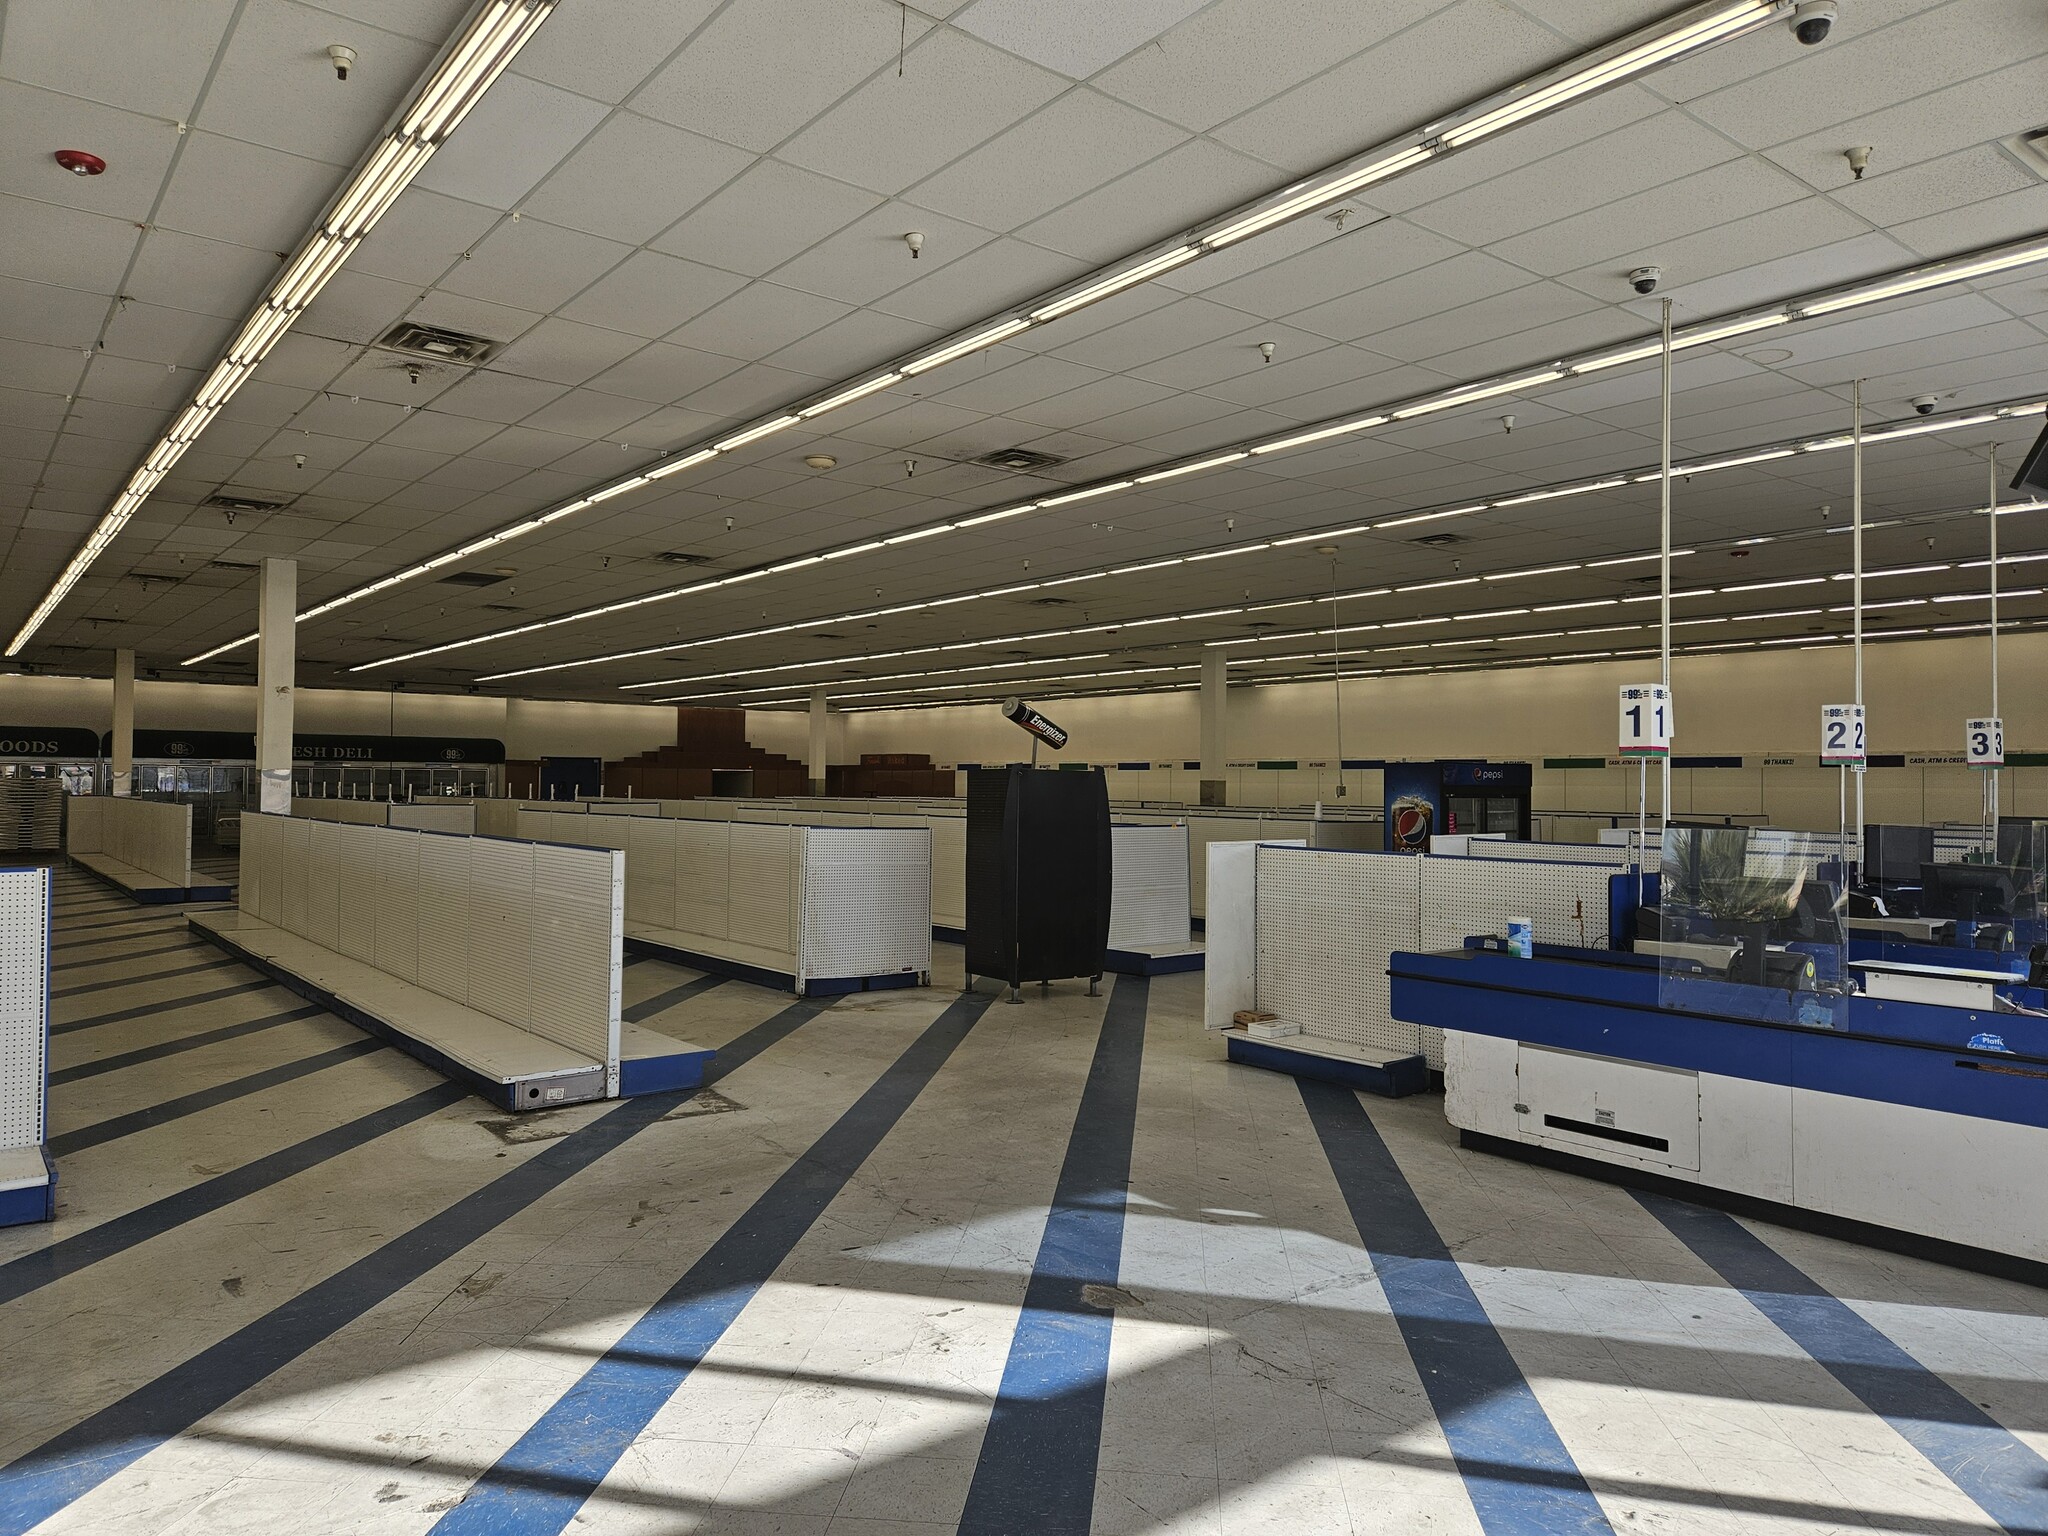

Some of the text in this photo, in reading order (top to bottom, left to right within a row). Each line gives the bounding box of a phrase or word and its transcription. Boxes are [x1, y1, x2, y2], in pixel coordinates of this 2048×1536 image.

[1030, 714, 1066, 742] Energizer
[1626, 705, 1640, 737] 1
[1656, 706, 1663, 737] 1
[0, 739, 59, 753] OODS
[1827, 722, 1846, 749] 2
[1855, 722, 1862, 749] 2
[1972, 733, 1989, 756] 3
[1995, 733, 2002, 756] 3
[332, 747, 373, 759] DELI
[1482, 770, 1503, 780] pepsi
